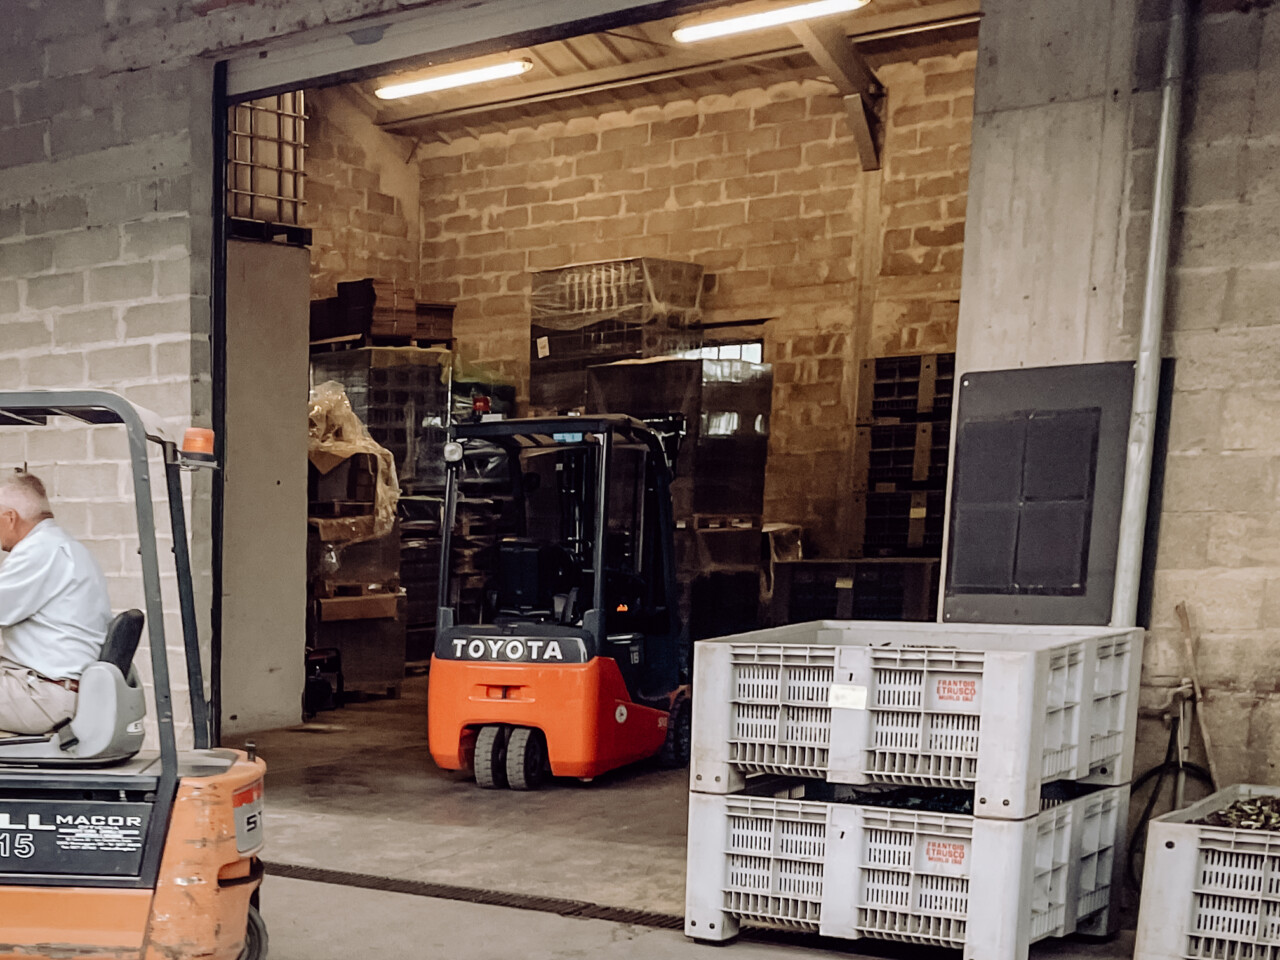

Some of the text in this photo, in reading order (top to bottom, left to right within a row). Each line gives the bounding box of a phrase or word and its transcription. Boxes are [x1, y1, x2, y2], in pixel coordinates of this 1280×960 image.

[453, 639, 563, 660] TOYOTA
[937, 680, 976, 688] FRANTOIO
[936, 686, 976, 696] ETRUSCO
[56, 815, 142, 826] MACOR
[927, 842, 965, 851] FRANTOIO
[926, 848, 965, 859] ETRUSCO
